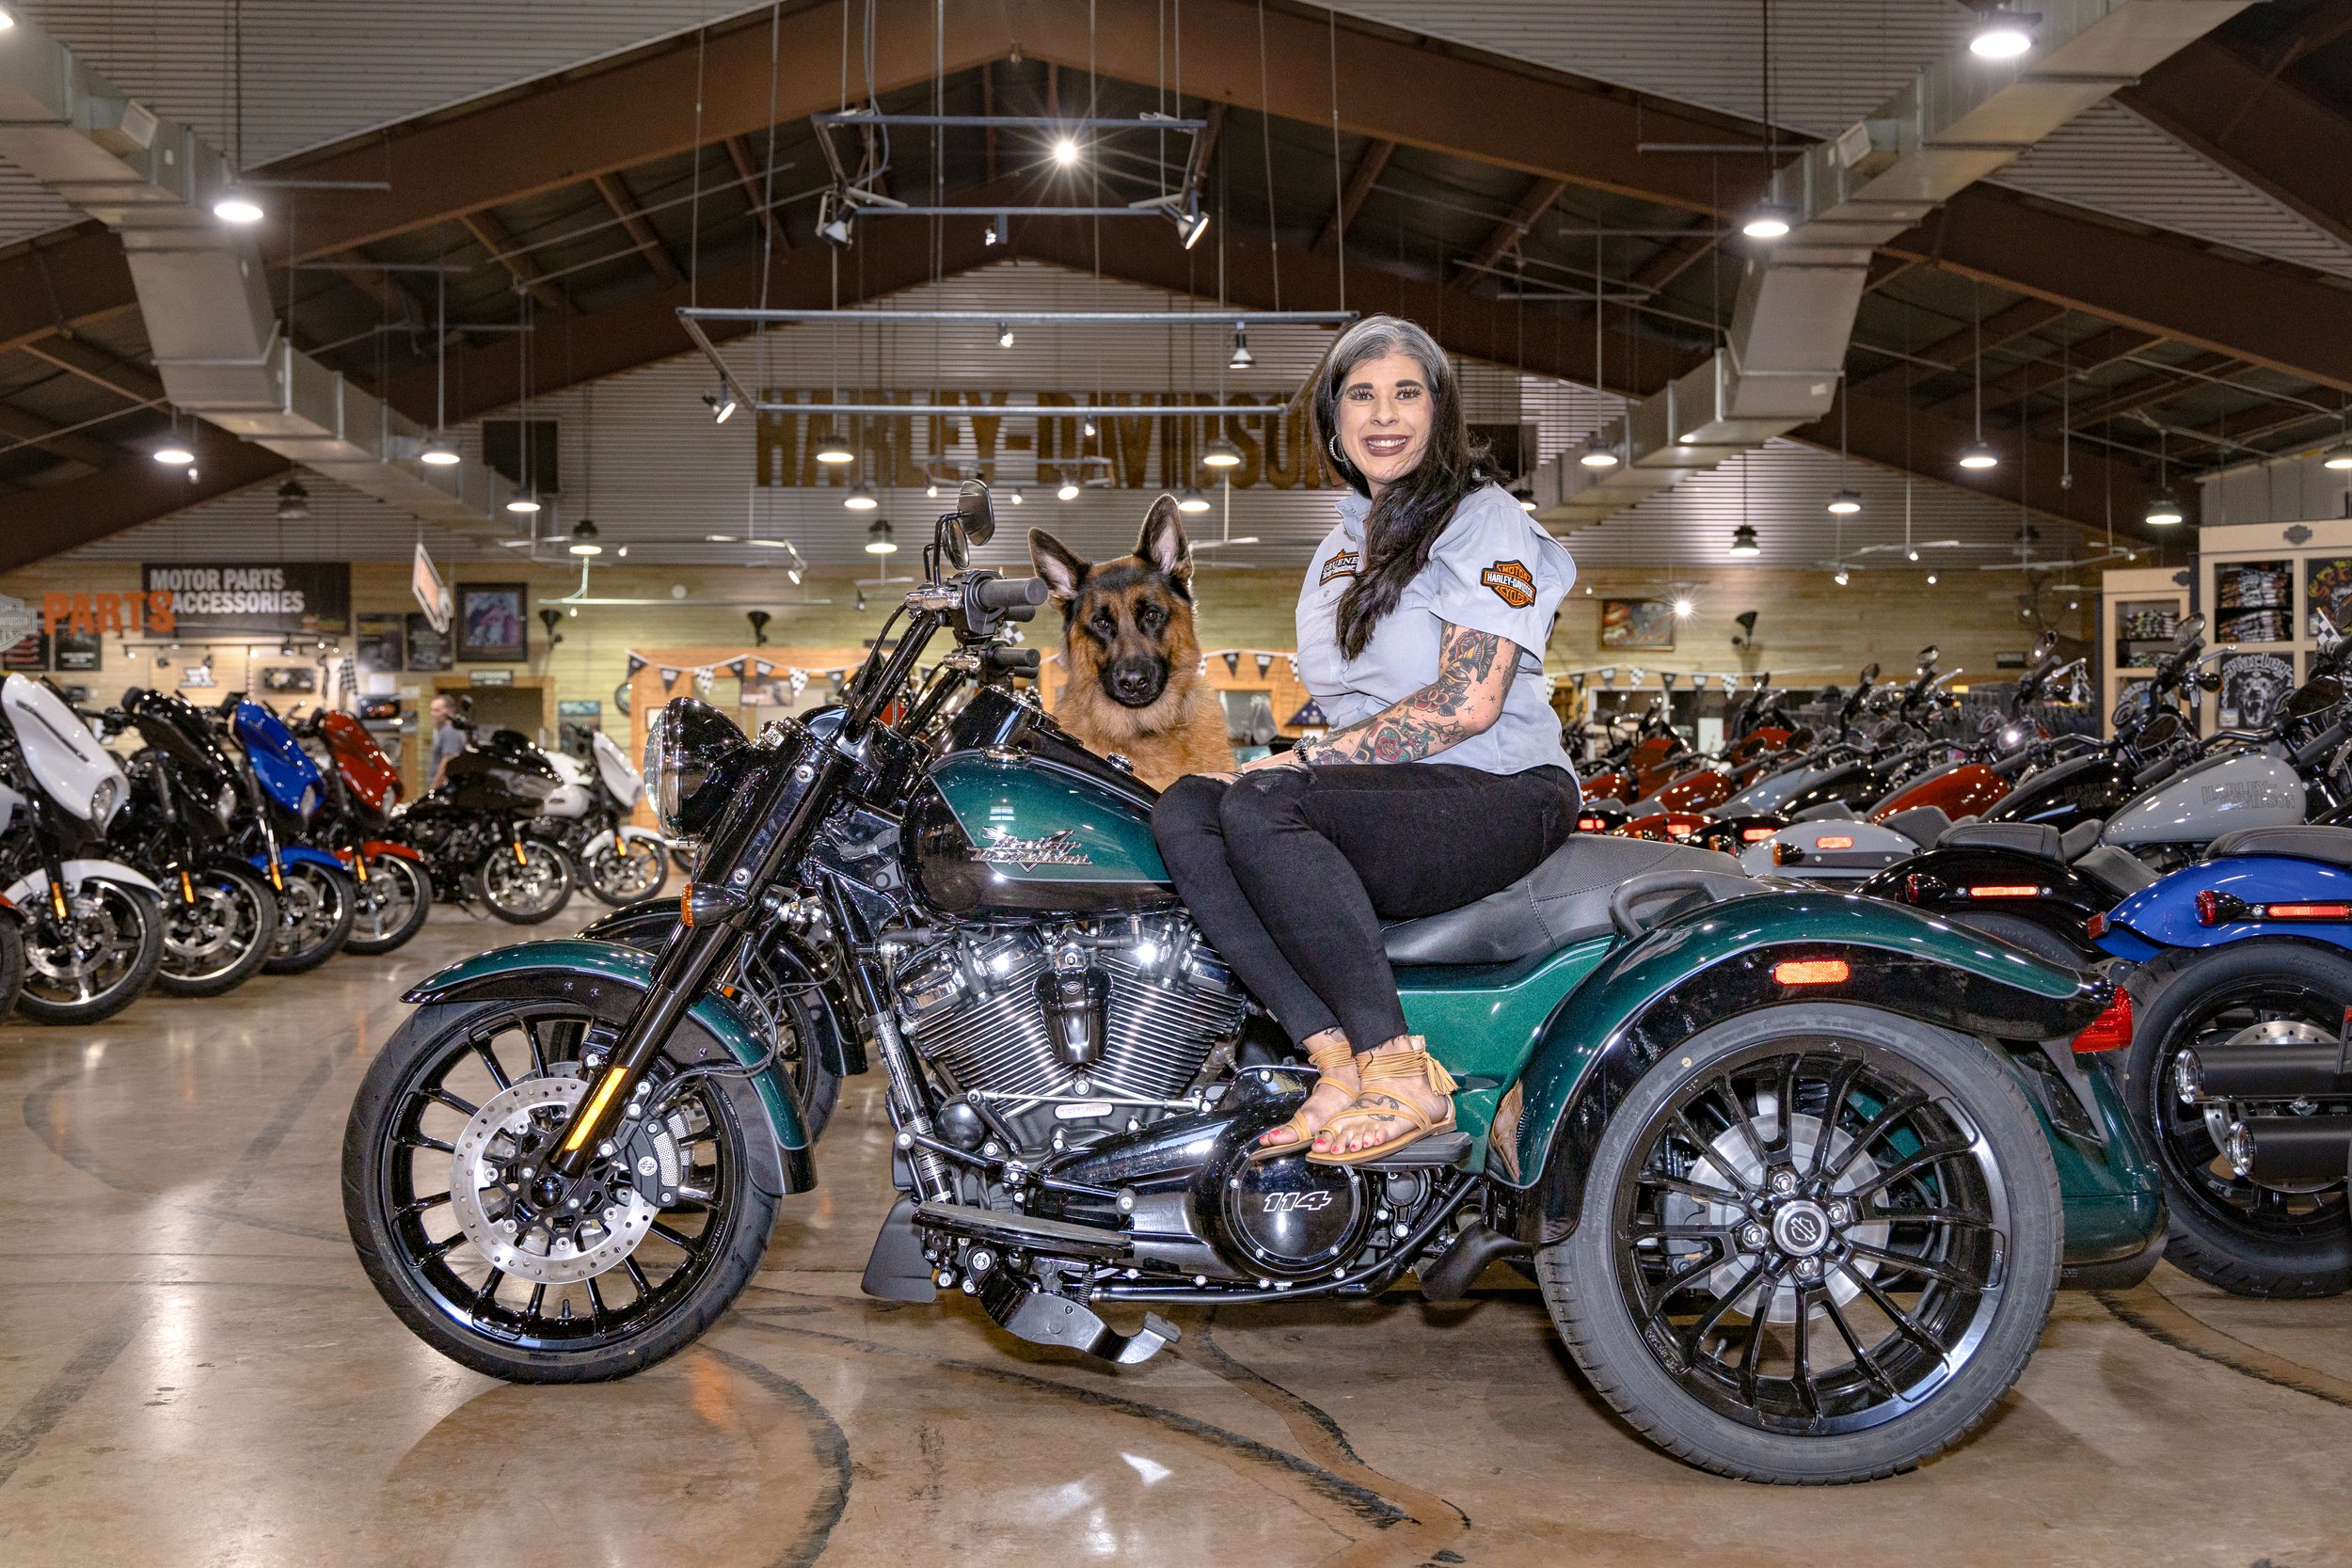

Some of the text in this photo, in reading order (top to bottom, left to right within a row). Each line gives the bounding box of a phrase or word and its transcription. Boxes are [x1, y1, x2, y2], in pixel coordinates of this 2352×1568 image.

[150, 568, 286, 591] MOTOR PARTS
[1502, 565, 1529, 580] MOTOR
[1486, 572, 1534, 599] HARLEY-DAVIDSON
[1500, 586, 1529, 603] CYCLES
[43, 590, 176, 634] PARTS
[170, 590, 305, 614] ACCESSORIES
[1263, 1191, 1332, 1212] 114
